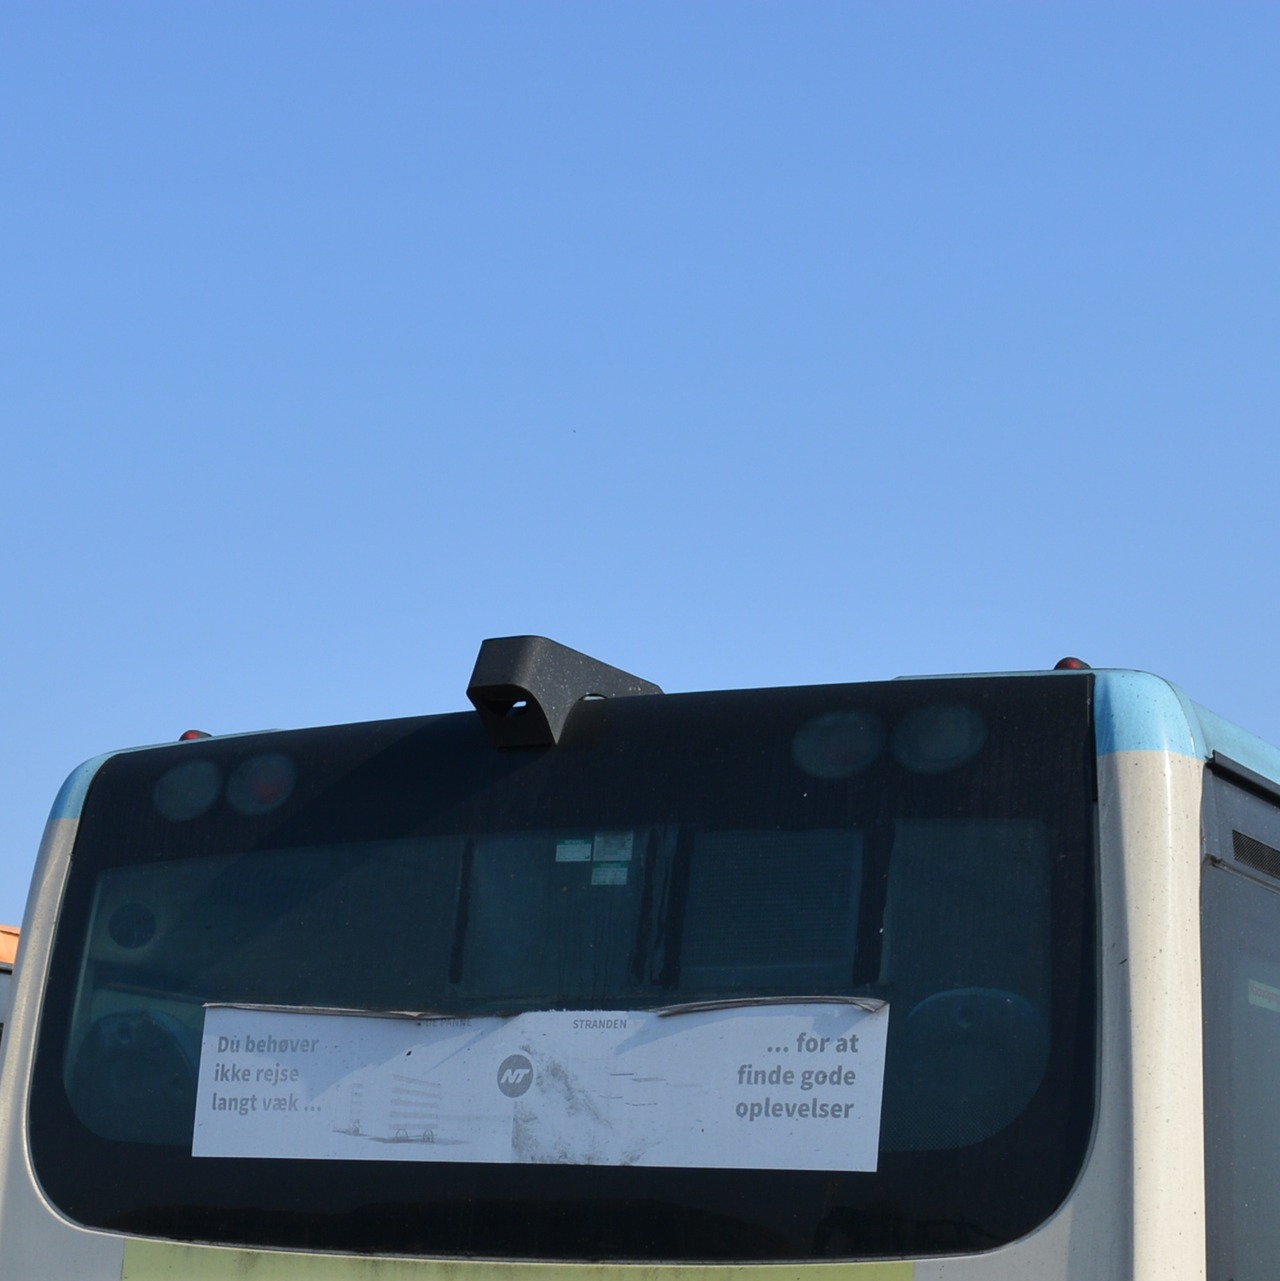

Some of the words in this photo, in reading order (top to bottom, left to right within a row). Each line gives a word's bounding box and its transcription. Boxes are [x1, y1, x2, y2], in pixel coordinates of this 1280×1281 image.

[573, 1019, 627, 1029] STRANDEN
[217, 1036, 240, 1053] Du
[245, 1034, 319, 1053] behøver
[796, 1032, 830, 1053] for
[835, 1034, 859, 1053] at
[214, 1063, 251, 1082] ikke
[256, 1063, 299, 1087] rejse
[500, 1068, 530, 1083] NT
[738, 1064, 795, 1085] finde
[800, 1065, 856, 1091] gode
[212, 1092, 257, 1116] langt
[263, 1093, 299, 1112] væk
[736, 1097, 855, 1121] oplevelser
